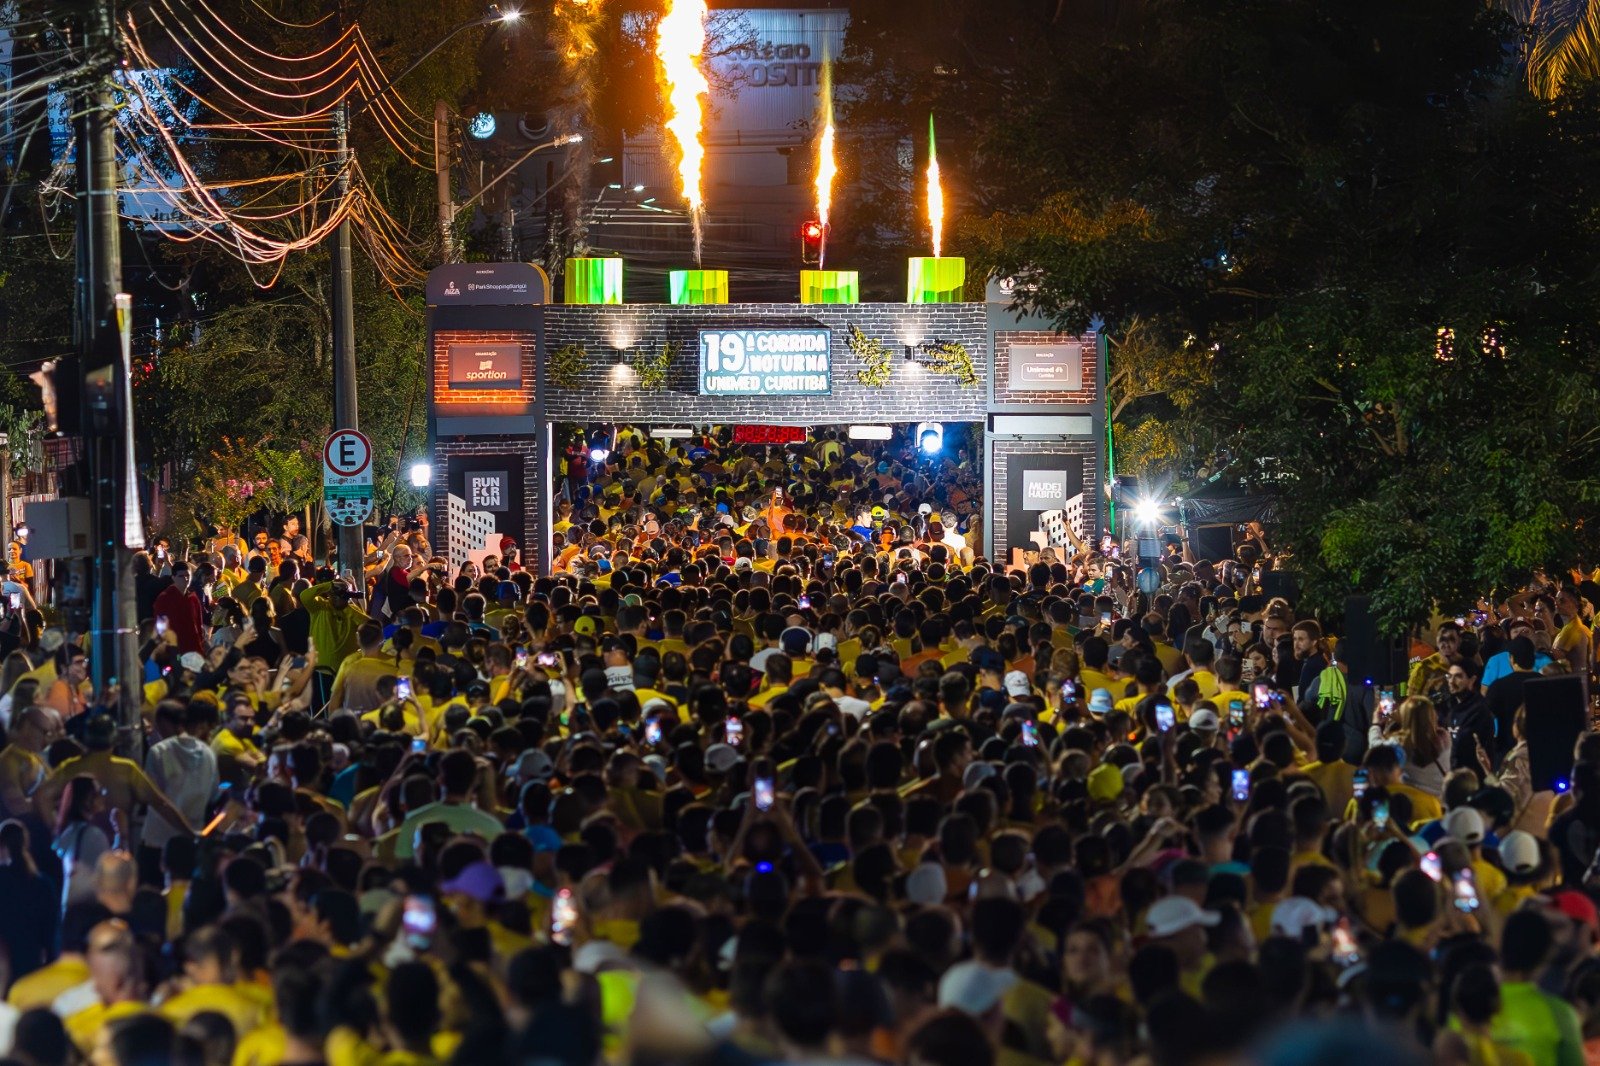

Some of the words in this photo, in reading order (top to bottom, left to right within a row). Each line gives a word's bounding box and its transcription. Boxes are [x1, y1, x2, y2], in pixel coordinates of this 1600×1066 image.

[757, 333, 827, 353] CORRIDA
[749, 354, 828, 373] NOTURNA
[466, 370, 507, 380] sportion
[706, 376, 760, 391] UNIMED
[764, 375, 828, 391] CURITIBA
[340, 440, 356, 466] E
[472, 477, 500, 487] RUN
[473, 497, 501, 506] FUN
